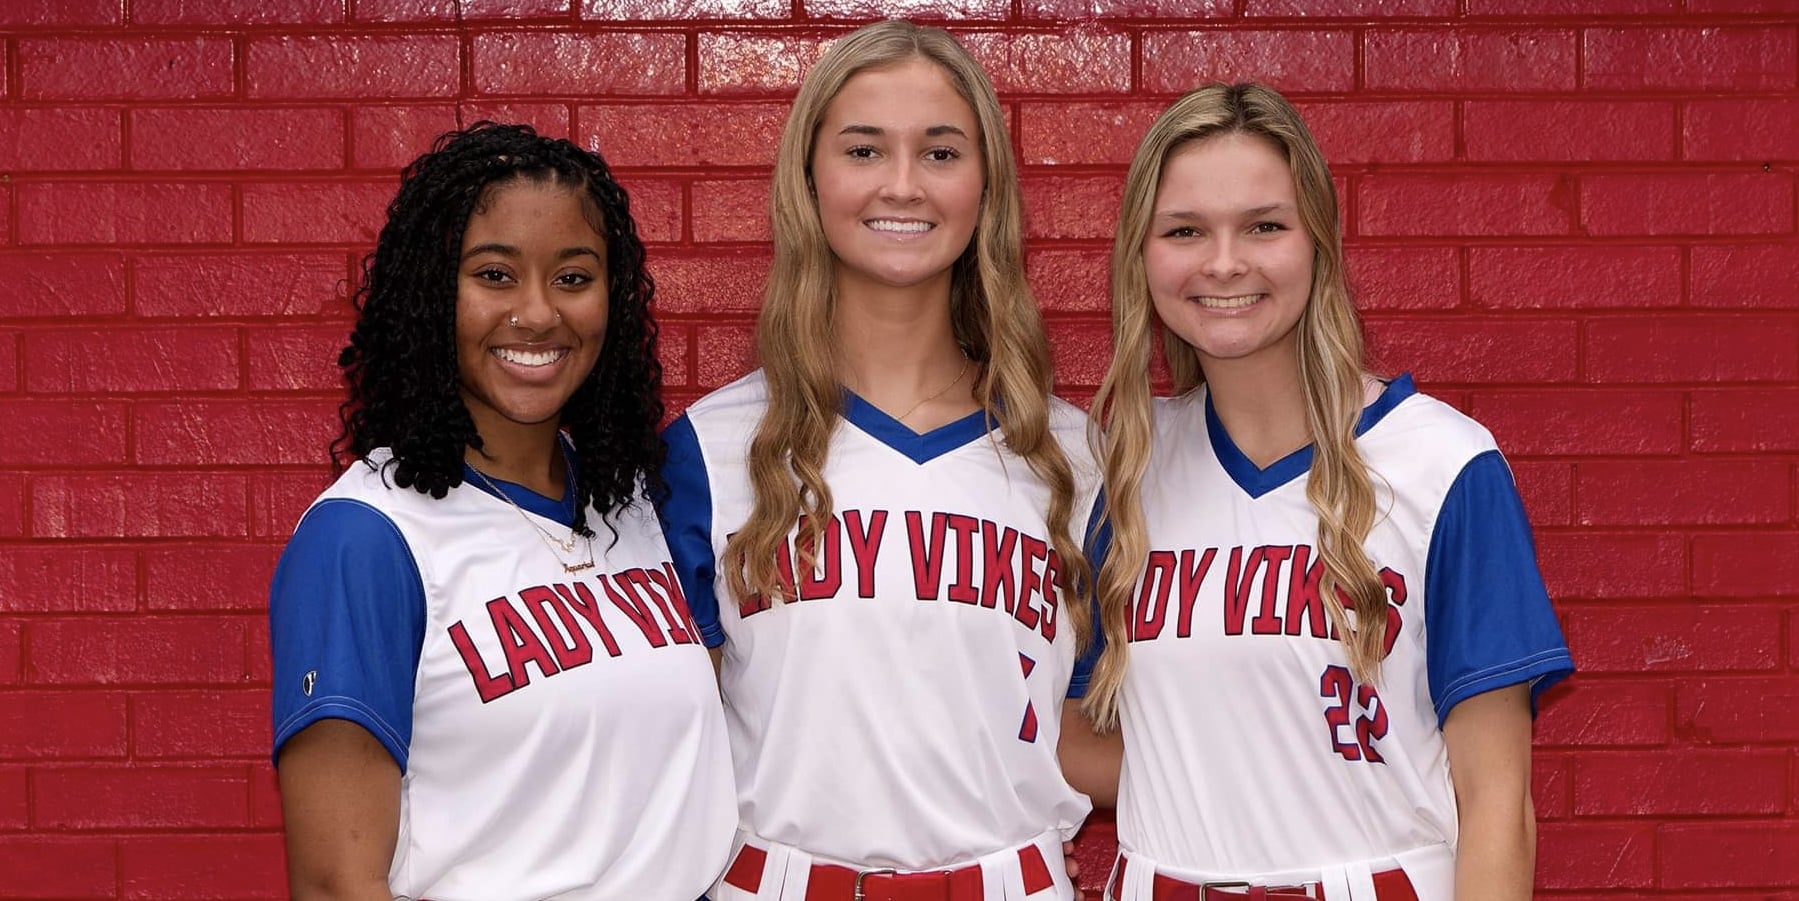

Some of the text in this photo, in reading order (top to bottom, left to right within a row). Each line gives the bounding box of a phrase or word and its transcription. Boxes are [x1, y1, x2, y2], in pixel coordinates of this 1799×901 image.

[447, 561, 706, 704] LADY VIK
[727, 509, 1063, 645] DY VIKES
[1124, 547, 1219, 643] DY
[1320, 664, 1389, 765] 22
